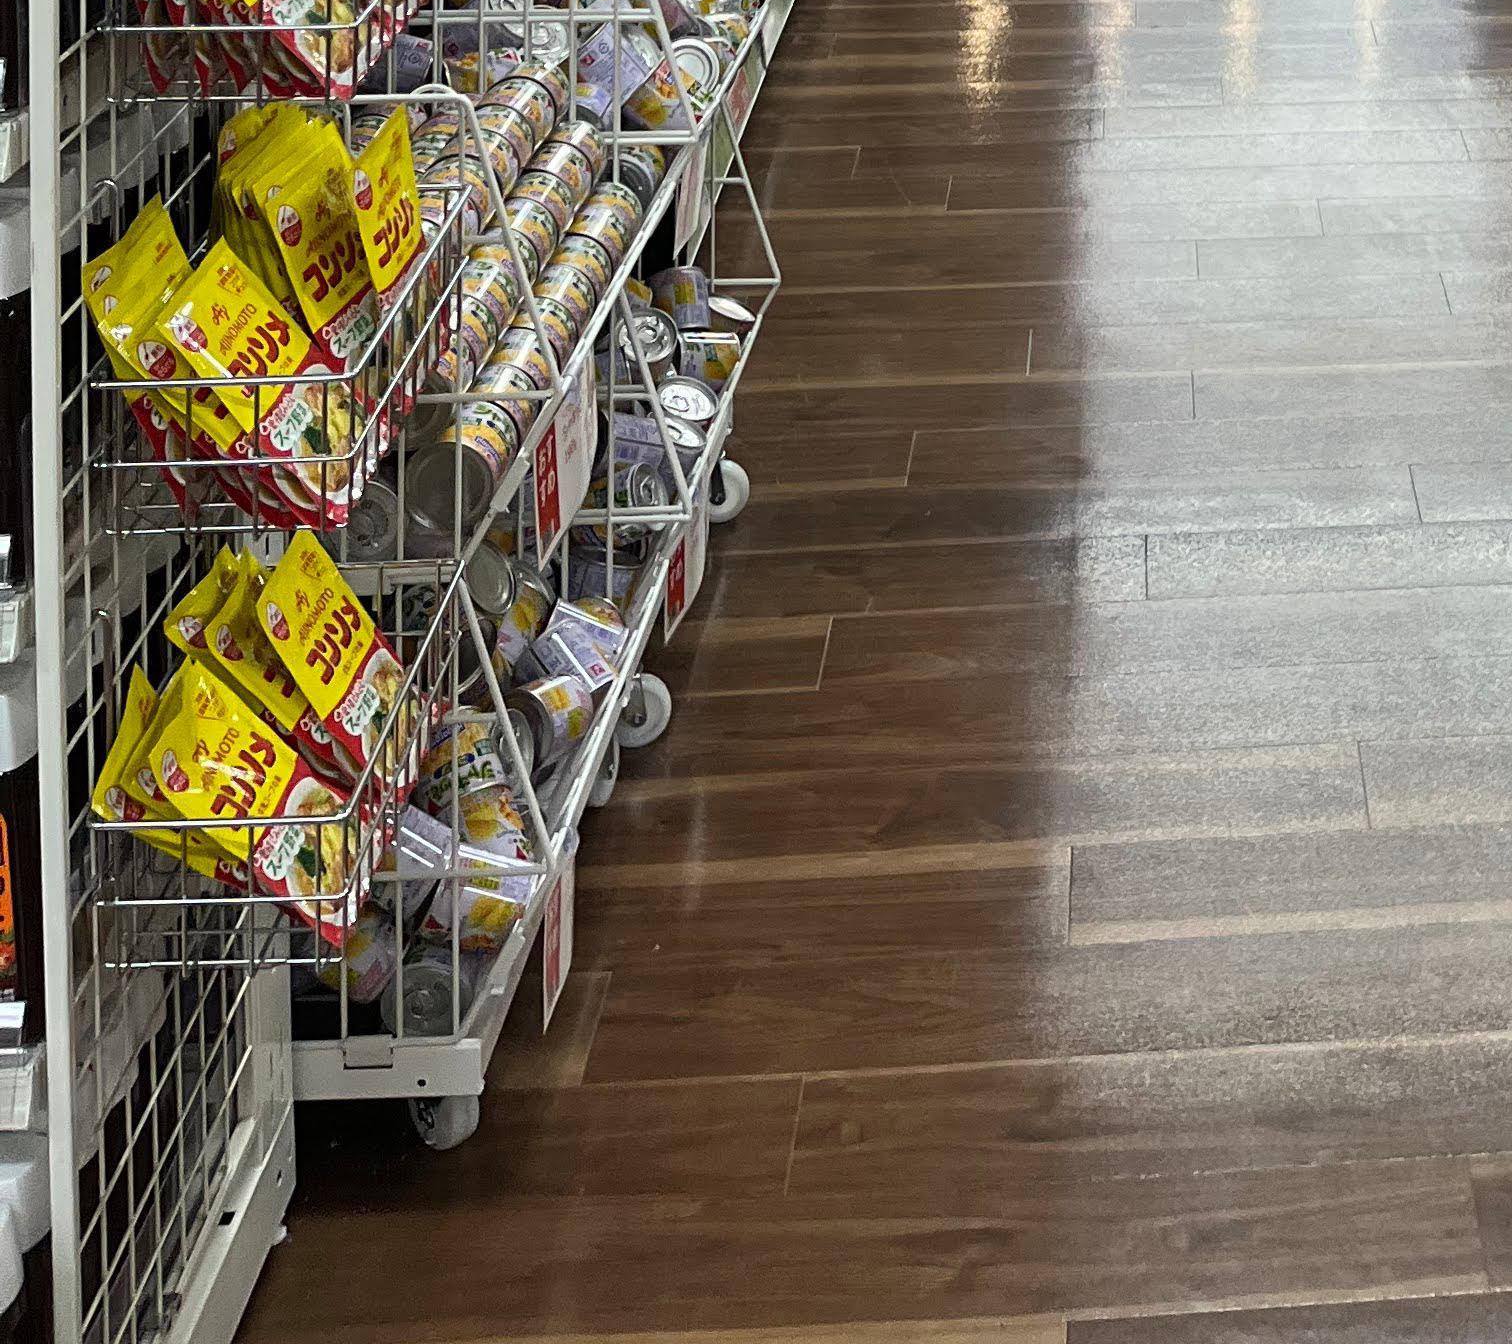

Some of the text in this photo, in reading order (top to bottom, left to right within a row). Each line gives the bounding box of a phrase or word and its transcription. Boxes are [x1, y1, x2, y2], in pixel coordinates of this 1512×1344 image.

[297, 587, 336, 647] AJINOMOTO
[305, 596, 363, 686] コンソメ
